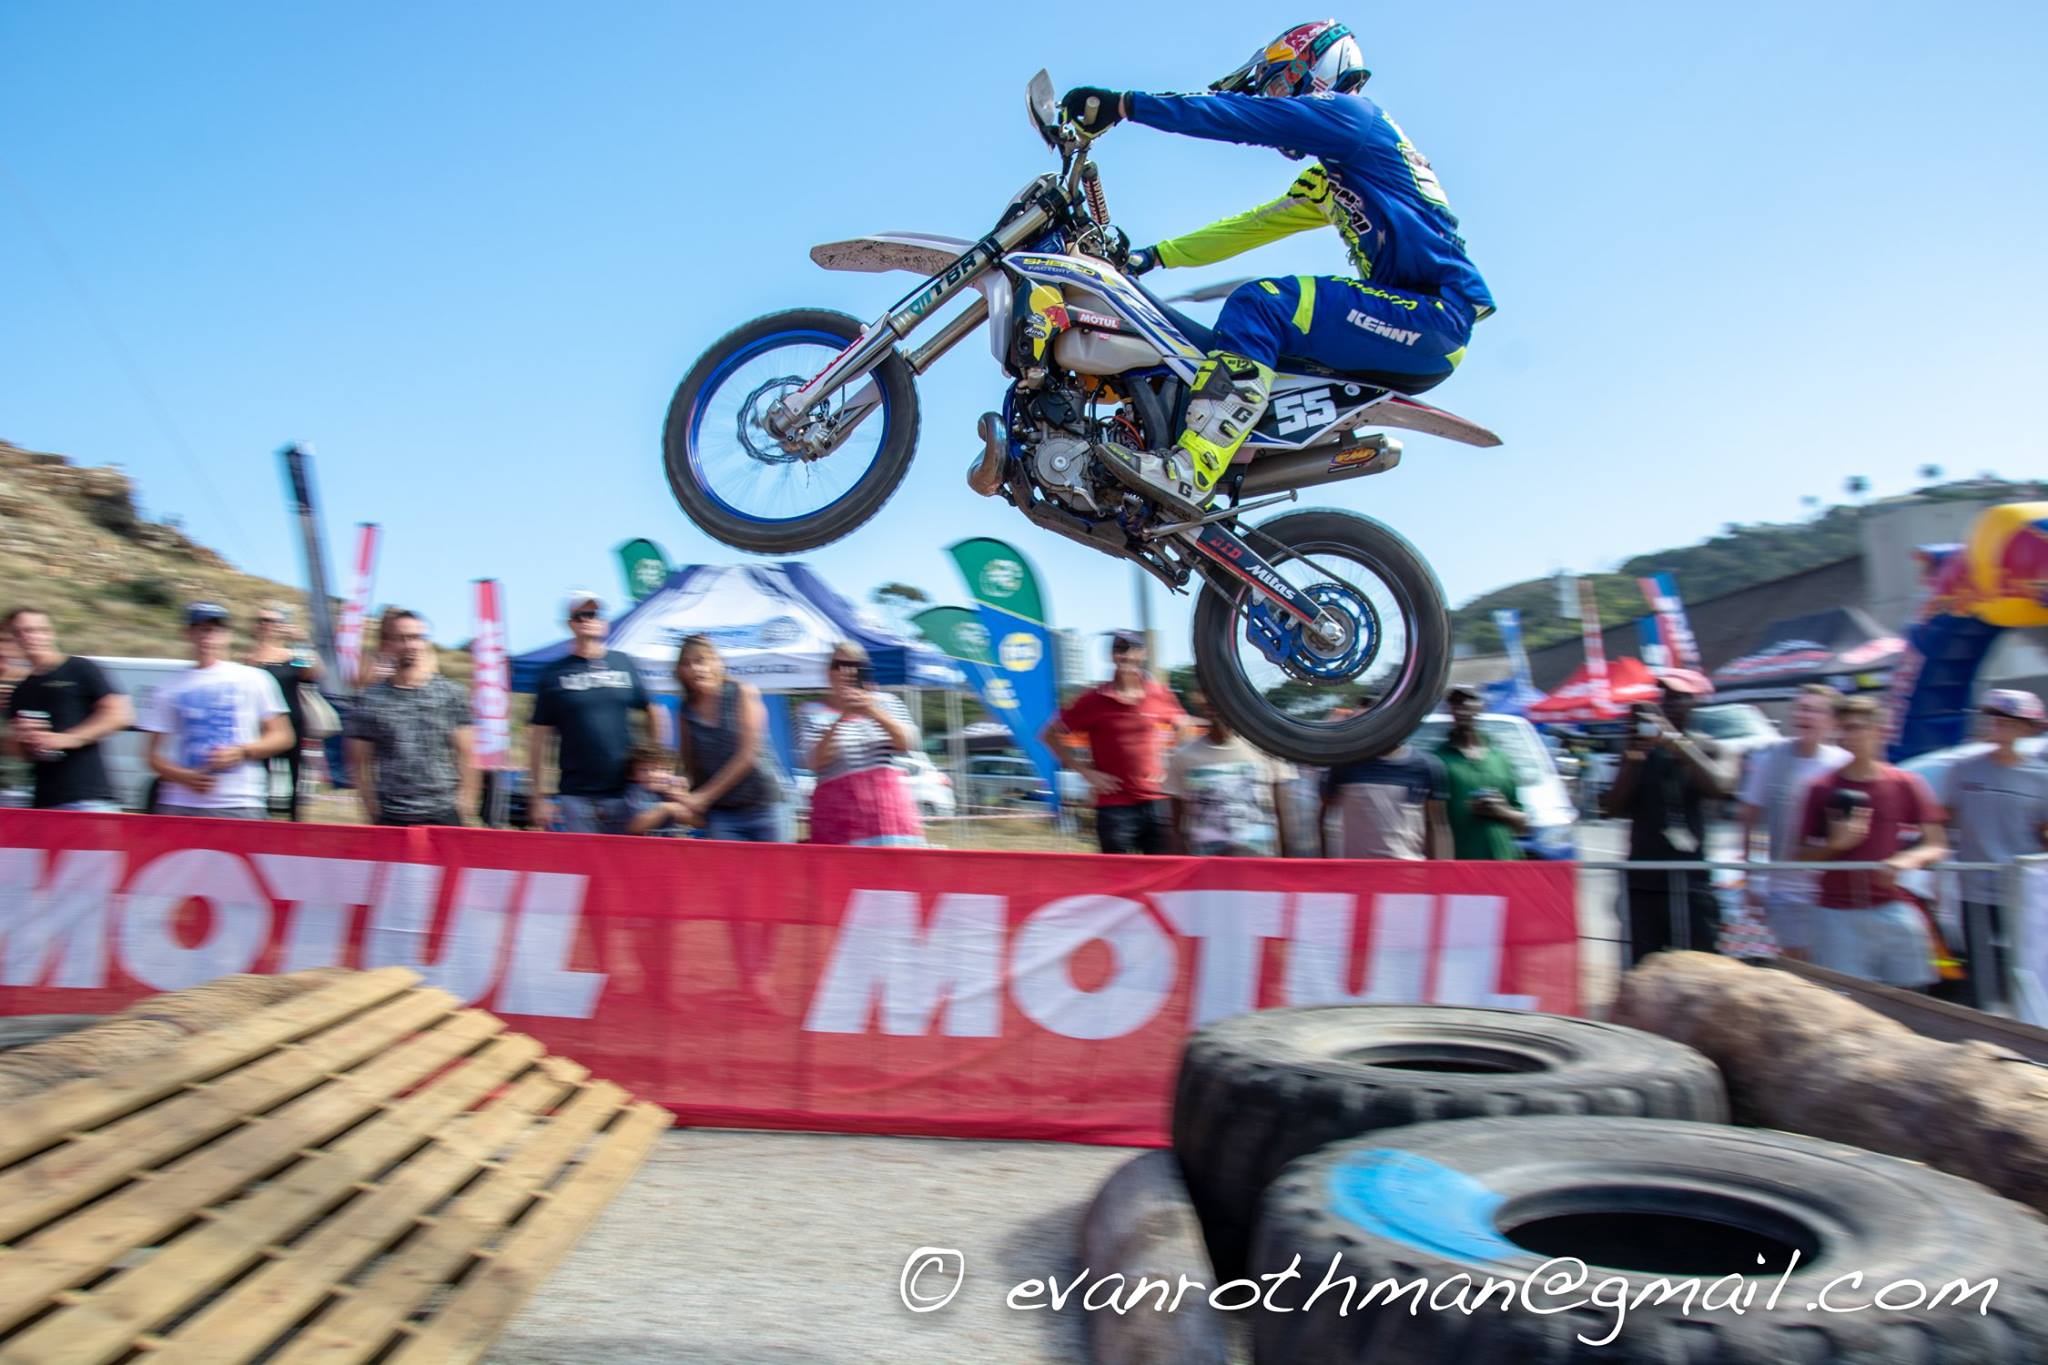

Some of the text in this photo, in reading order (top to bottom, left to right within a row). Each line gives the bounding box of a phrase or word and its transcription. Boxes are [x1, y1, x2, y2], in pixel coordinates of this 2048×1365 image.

[930, 253, 977, 296] TBR
[1079, 313, 1119, 328] MOTUL
[1346, 308, 1422, 347] KENNY
[1274, 387, 1337, 436] 55
[1246, 565, 1297, 601] Mitas
[0, 847, 608, 1018] MOTUL
[803, 888, 1540, 1039] MOTUL
